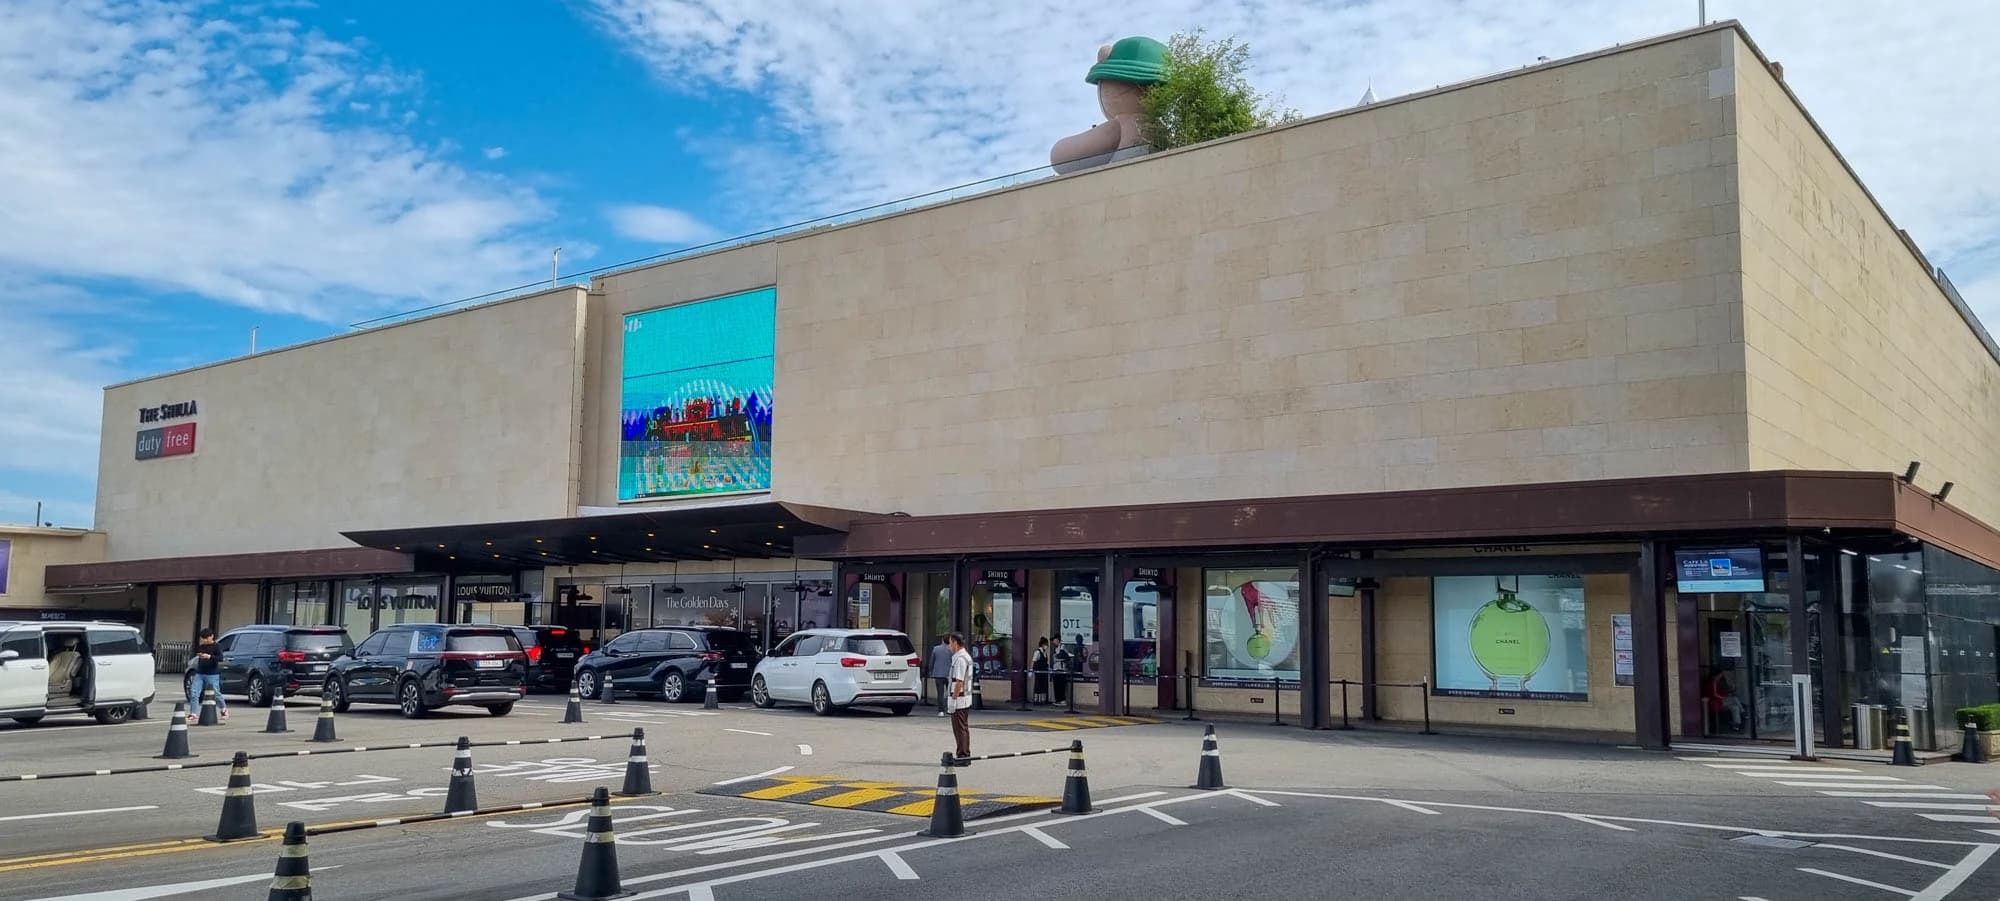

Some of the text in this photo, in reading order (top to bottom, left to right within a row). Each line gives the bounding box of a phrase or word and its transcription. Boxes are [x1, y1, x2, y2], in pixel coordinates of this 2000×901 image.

[139, 408, 159, 423] THE
[139, 431, 189, 455] duty free
[389, 594, 437, 610] VUITTON
[665, 595, 728, 609] The Golden Days
